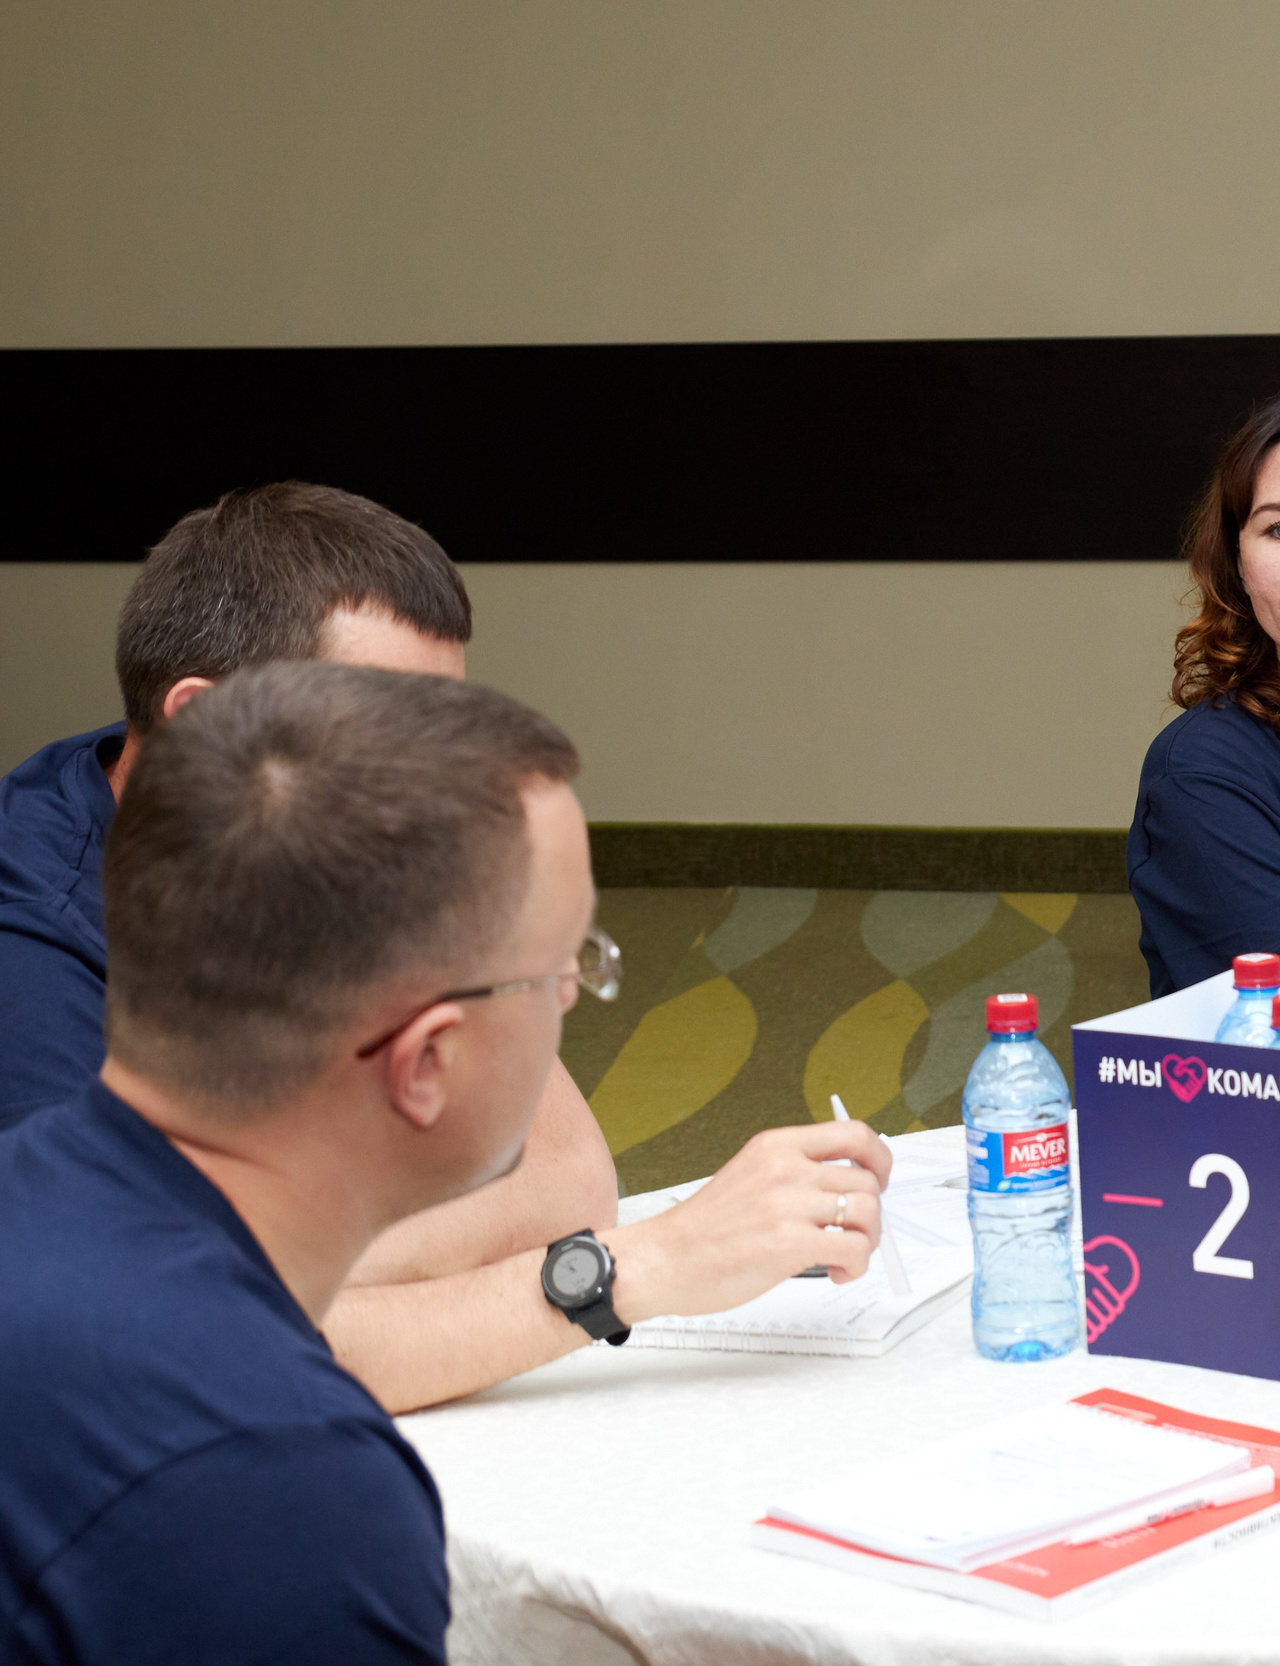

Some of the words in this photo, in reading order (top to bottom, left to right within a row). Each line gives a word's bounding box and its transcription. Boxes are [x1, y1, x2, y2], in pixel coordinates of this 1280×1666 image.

[1098, 1056, 1162, 1088] #МЫ
[1010, 1137, 1066, 1163] MEVER
[1188, 1152, 1255, 1280] 2
